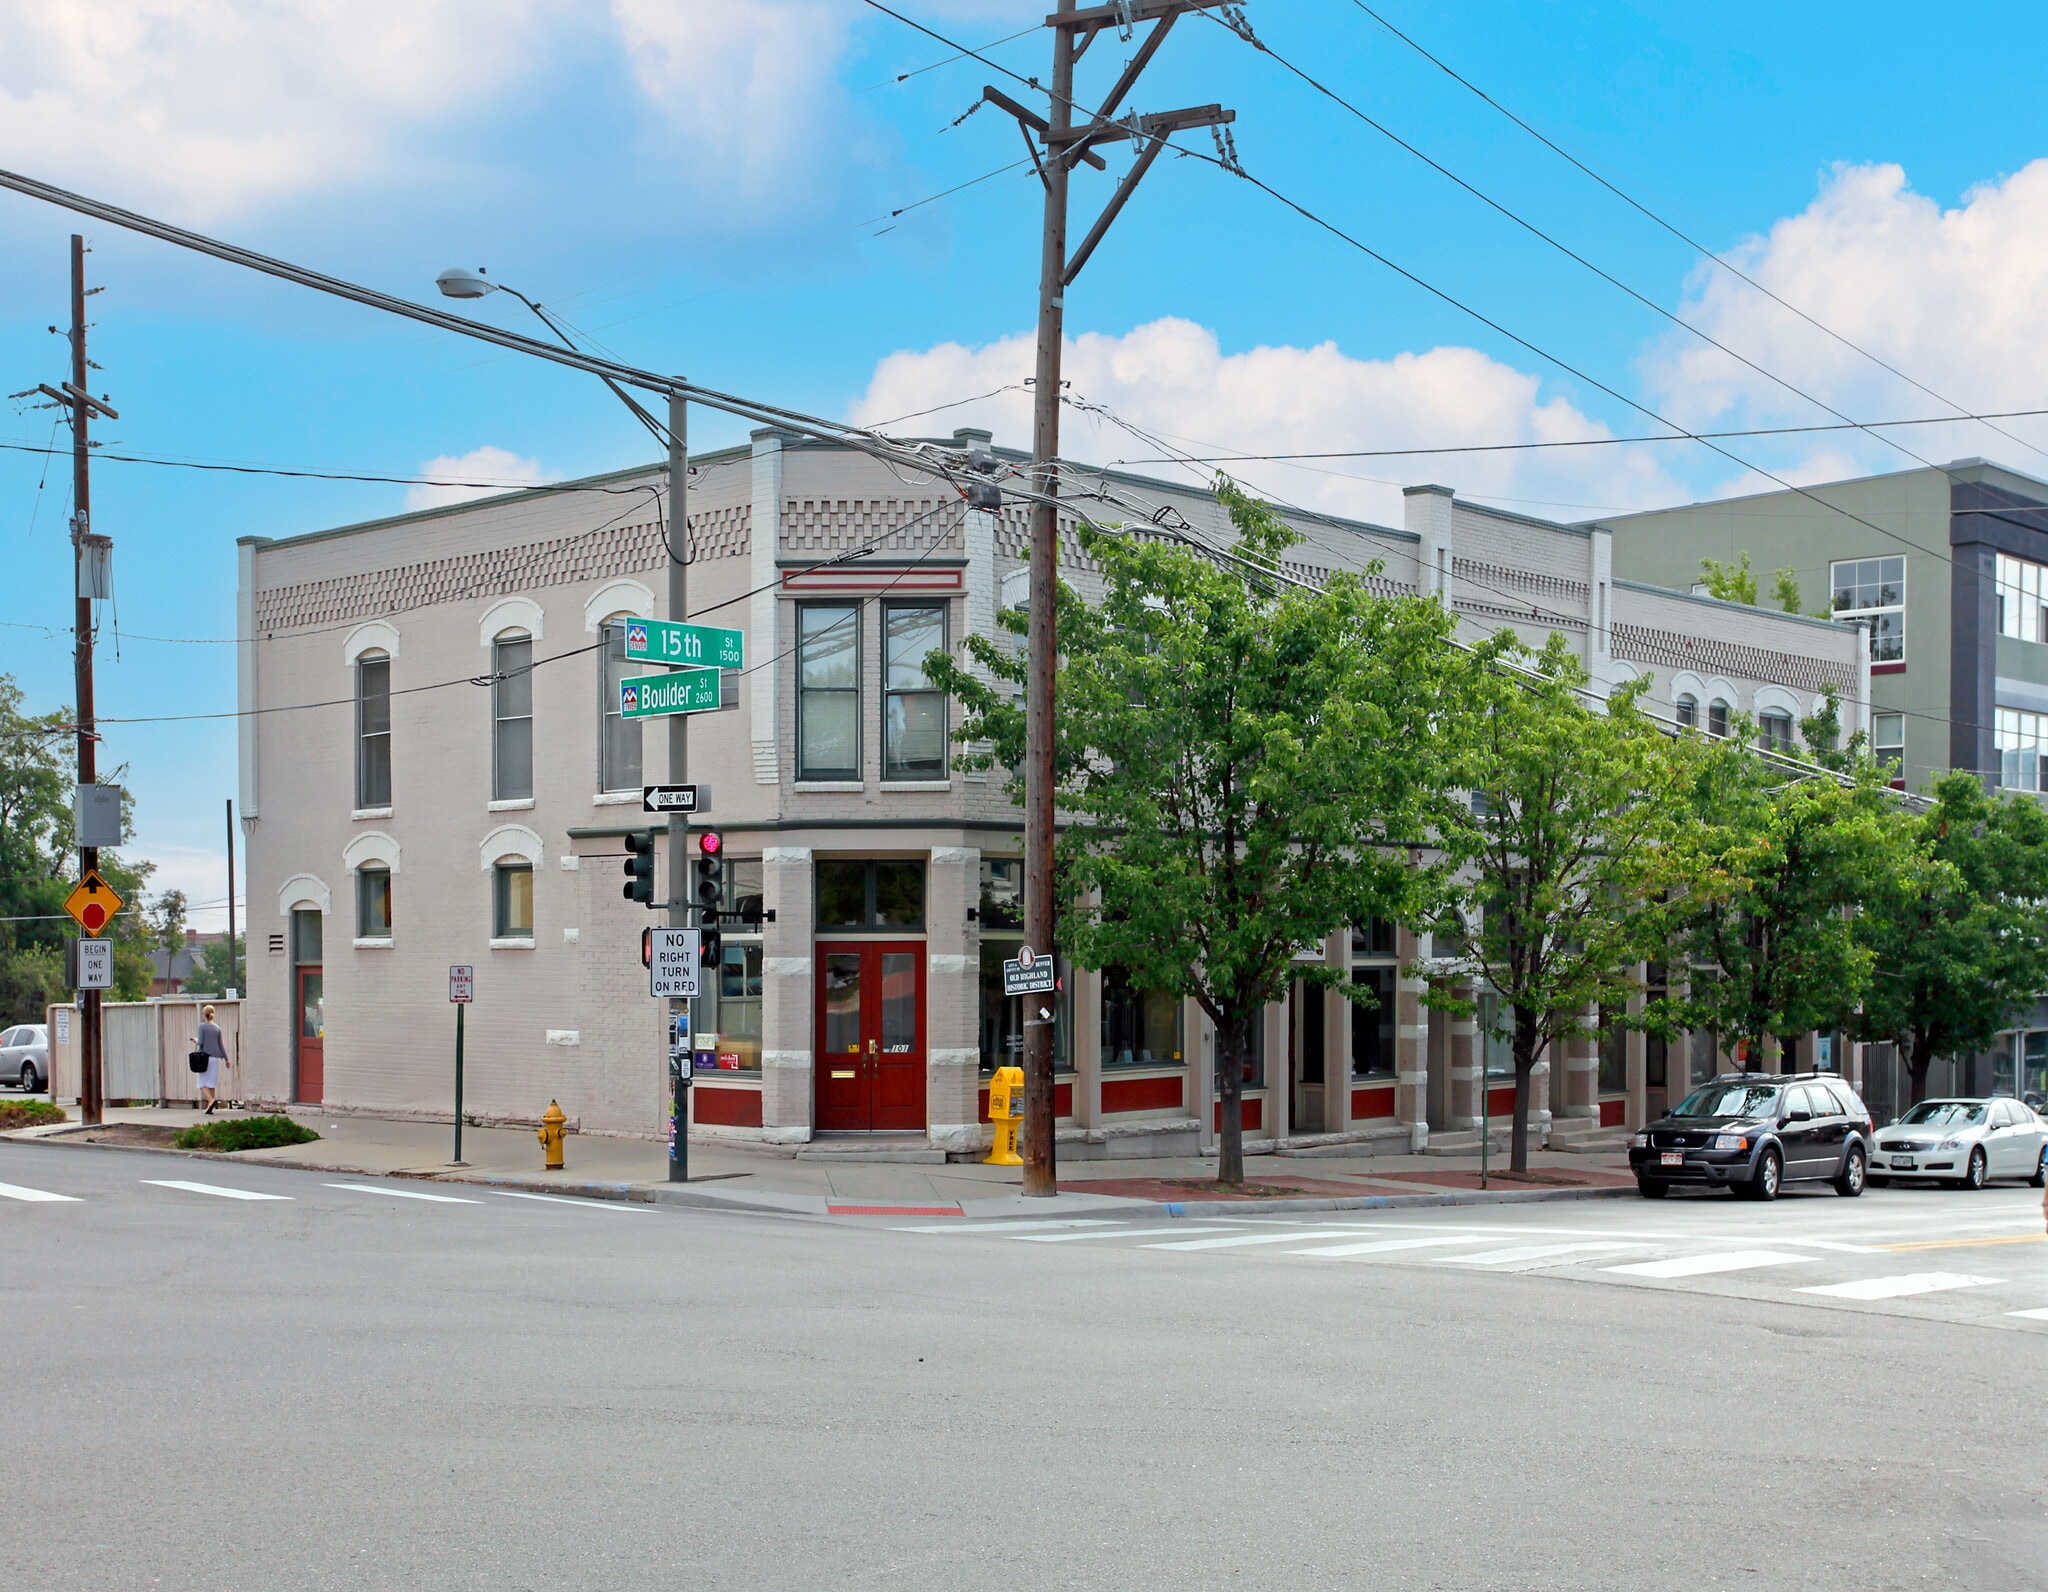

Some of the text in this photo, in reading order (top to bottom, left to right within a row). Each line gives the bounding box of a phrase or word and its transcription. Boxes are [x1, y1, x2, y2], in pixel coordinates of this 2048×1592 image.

[661, 629, 702, 658] 15th
[725, 637, 733, 648] St
[719, 650, 740, 662] 1500
[700, 677, 708, 688] St
[641, 682, 692, 710] Boulder
[695, 691, 713, 703] 2600
[658, 793, 691, 804] ONE WAY
[666, 933, 684, 947] NO
[84, 944, 107, 954] BEGIN
[659, 952, 691, 962] RIGHT
[87, 960, 103, 969] ONE
[457, 967, 465, 975] NO
[661, 966, 690, 977] TURN
[1010, 971, 1048, 982] OLD HIGHLAND
[87, 974, 103, 982] WAY
[655, 981, 695, 992] ON RED
[1007, 980, 1051, 991] HISTORIC DISTRICT
[892, 1044, 909, 1053] 101
